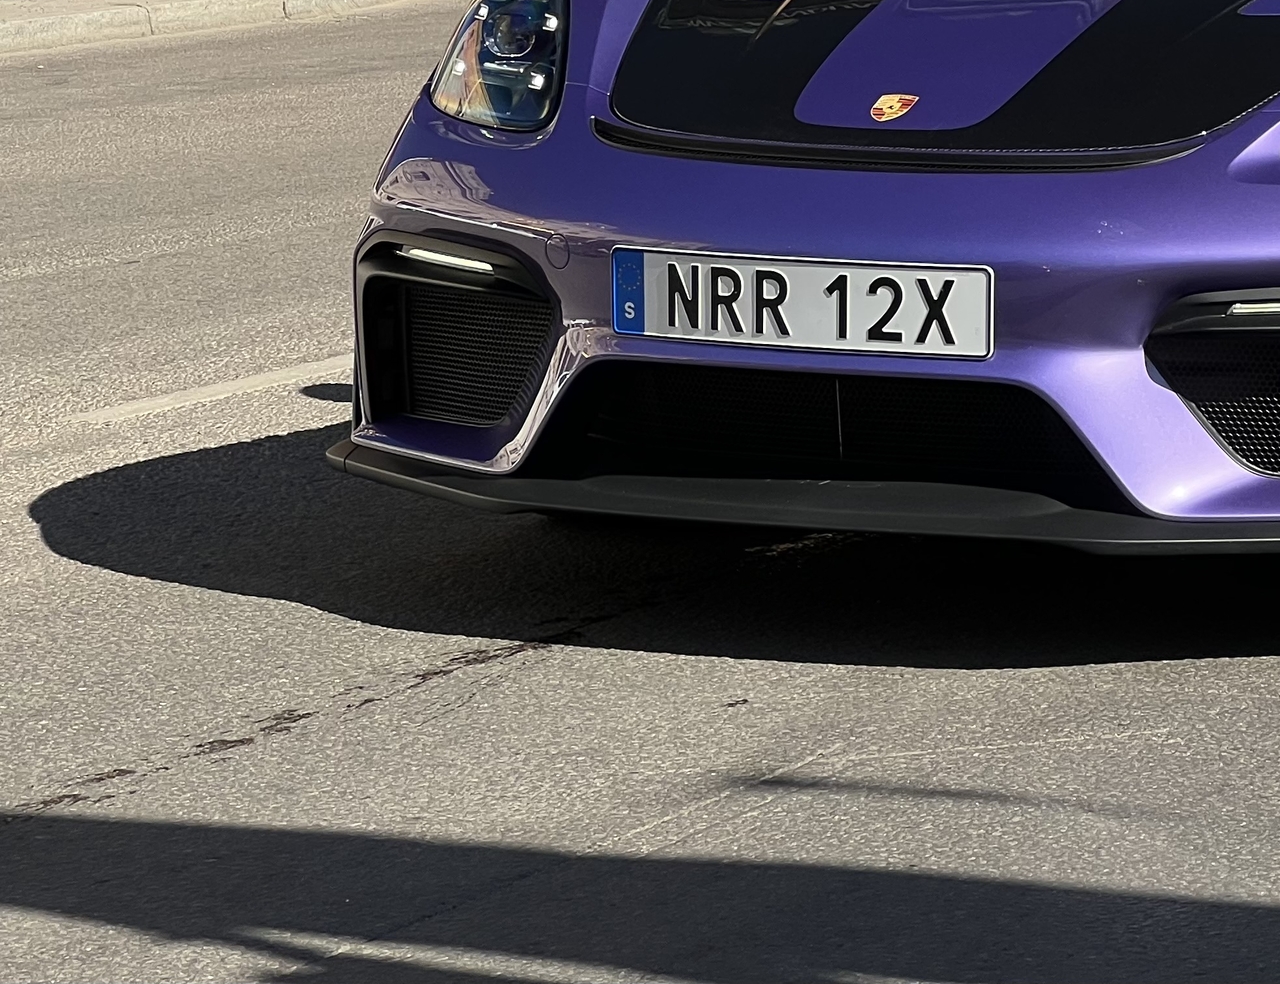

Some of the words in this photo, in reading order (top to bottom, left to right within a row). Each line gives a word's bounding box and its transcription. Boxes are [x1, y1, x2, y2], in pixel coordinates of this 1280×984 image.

[624, 301, 635, 319] S
[667, 262, 790, 336] NRR
[825, 273, 955, 345] 12X
